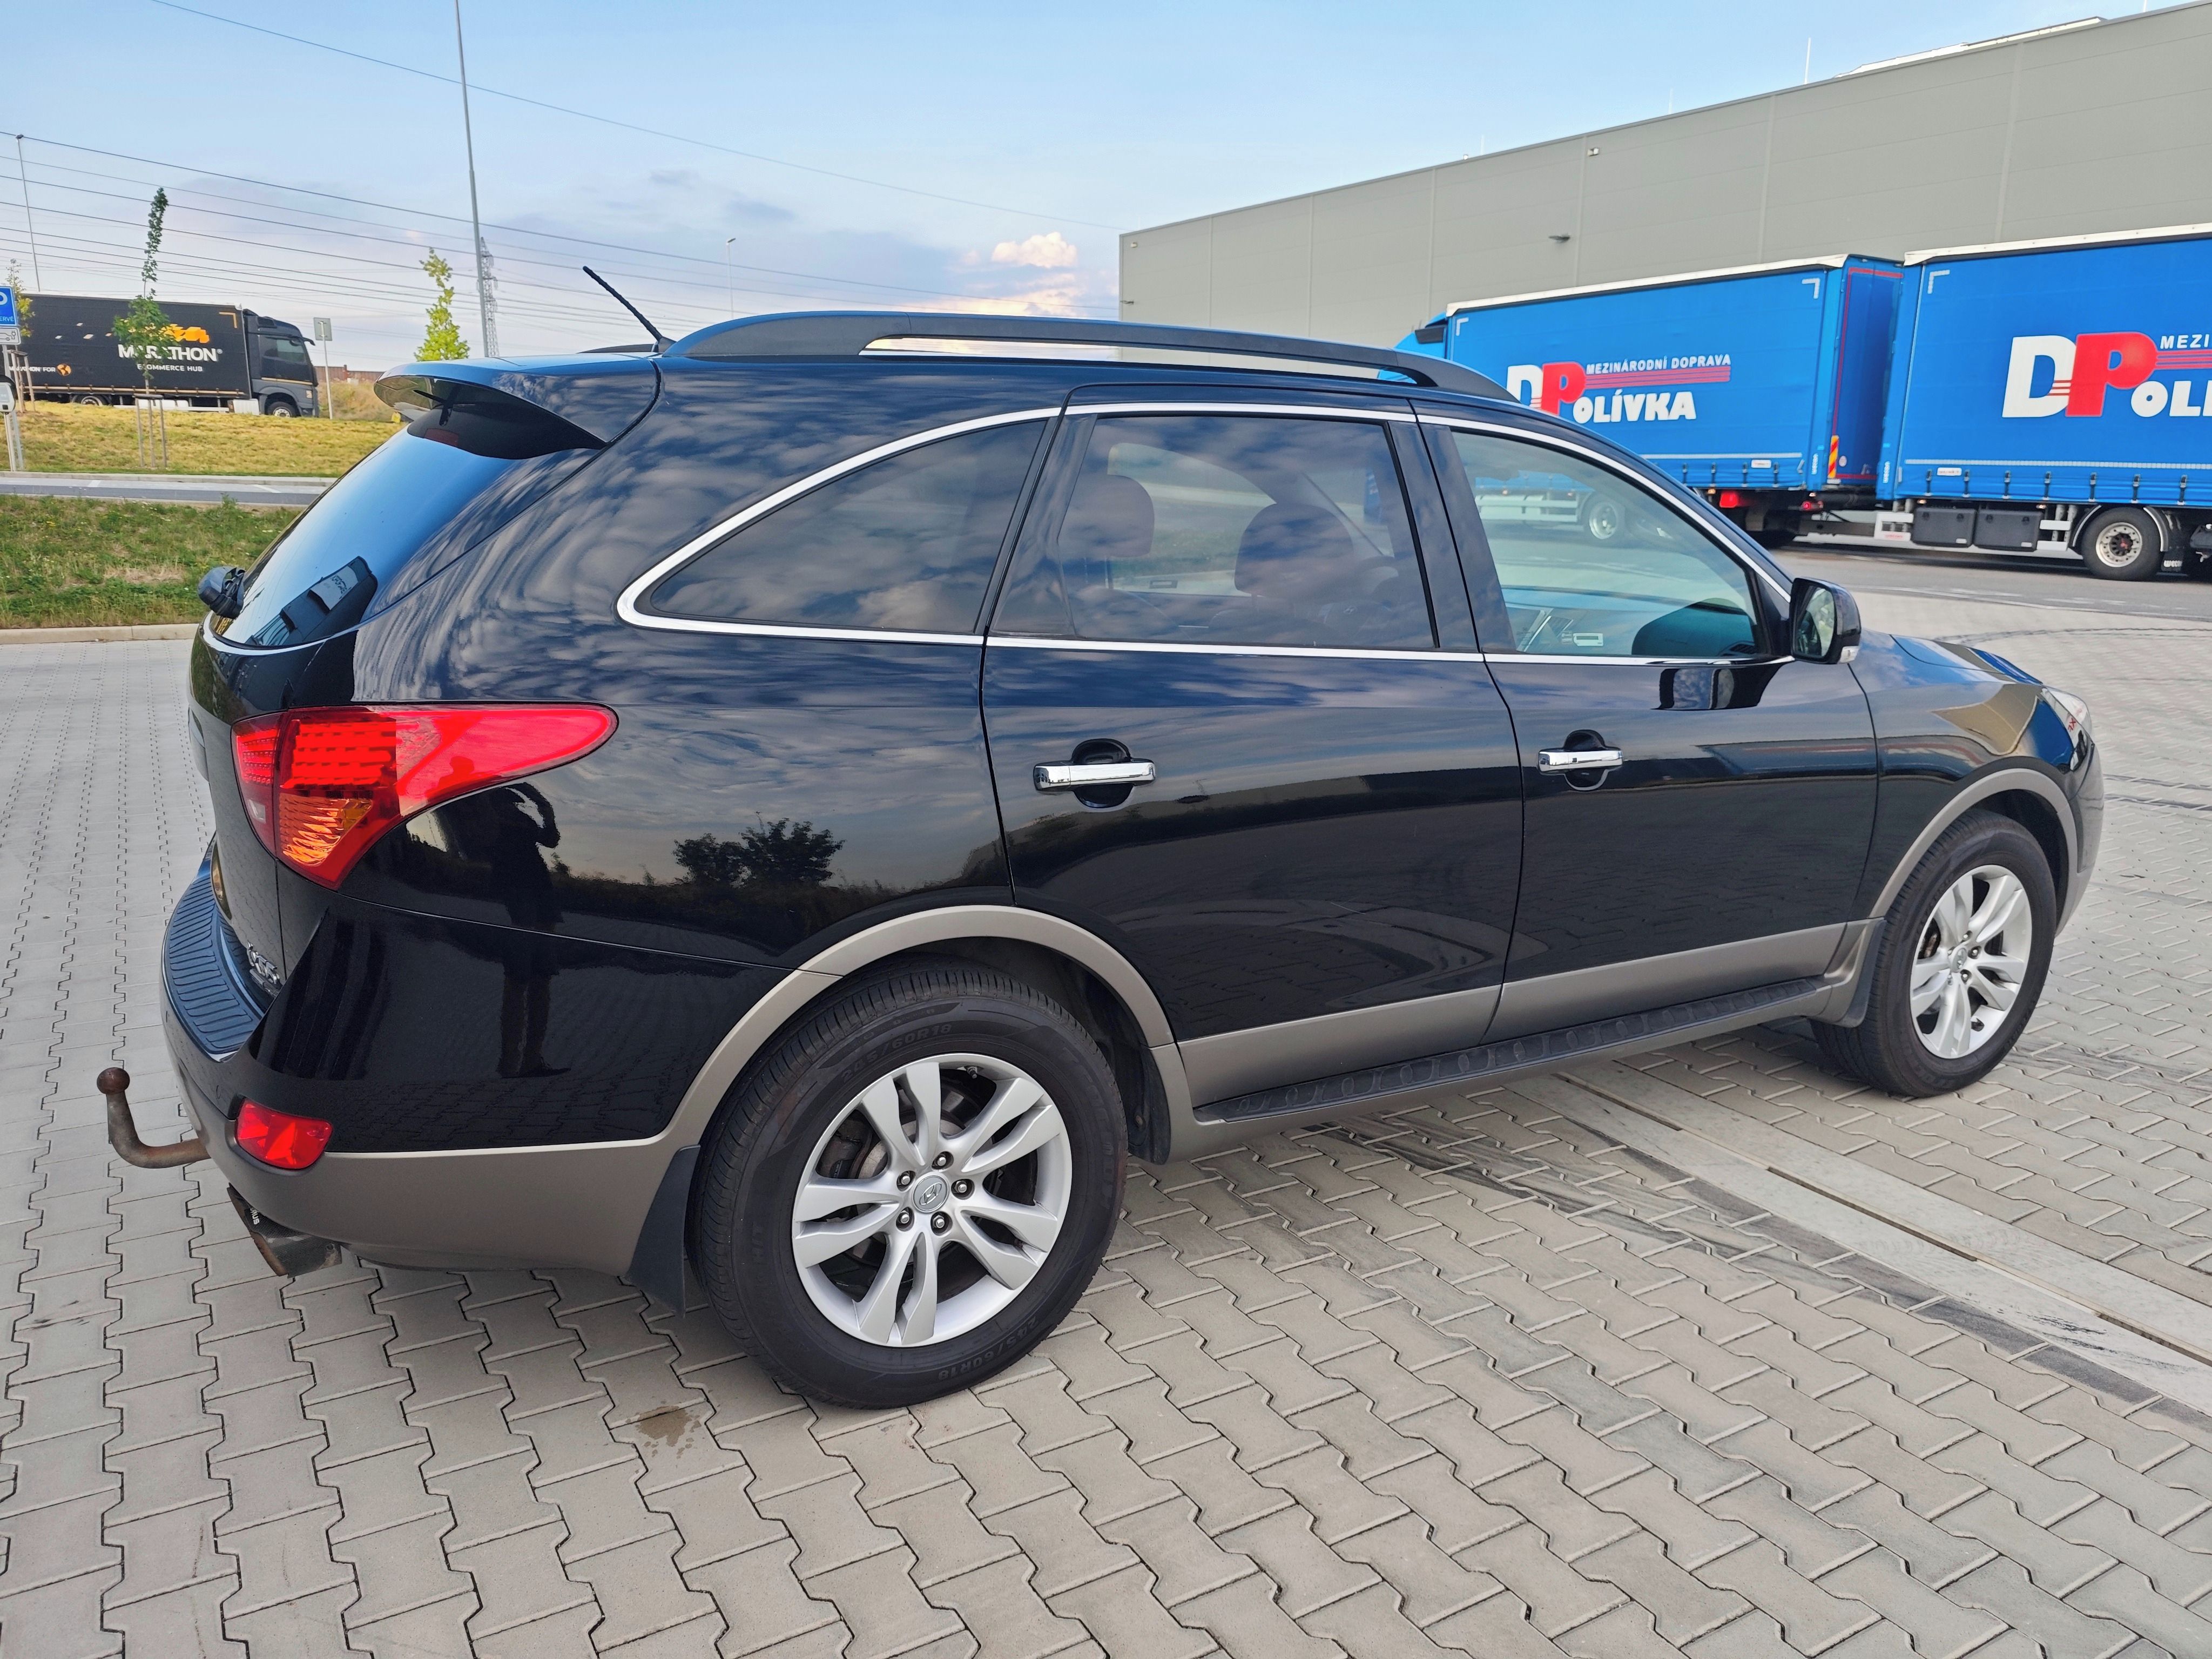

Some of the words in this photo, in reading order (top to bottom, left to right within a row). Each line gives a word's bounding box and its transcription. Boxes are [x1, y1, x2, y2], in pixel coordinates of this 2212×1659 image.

[137, 363, 185, 372] EOMMERCE
[1586, 355, 1668, 375] MEZINÁRODNÍ
[1671, 354, 1731, 369] DOPRAVA
